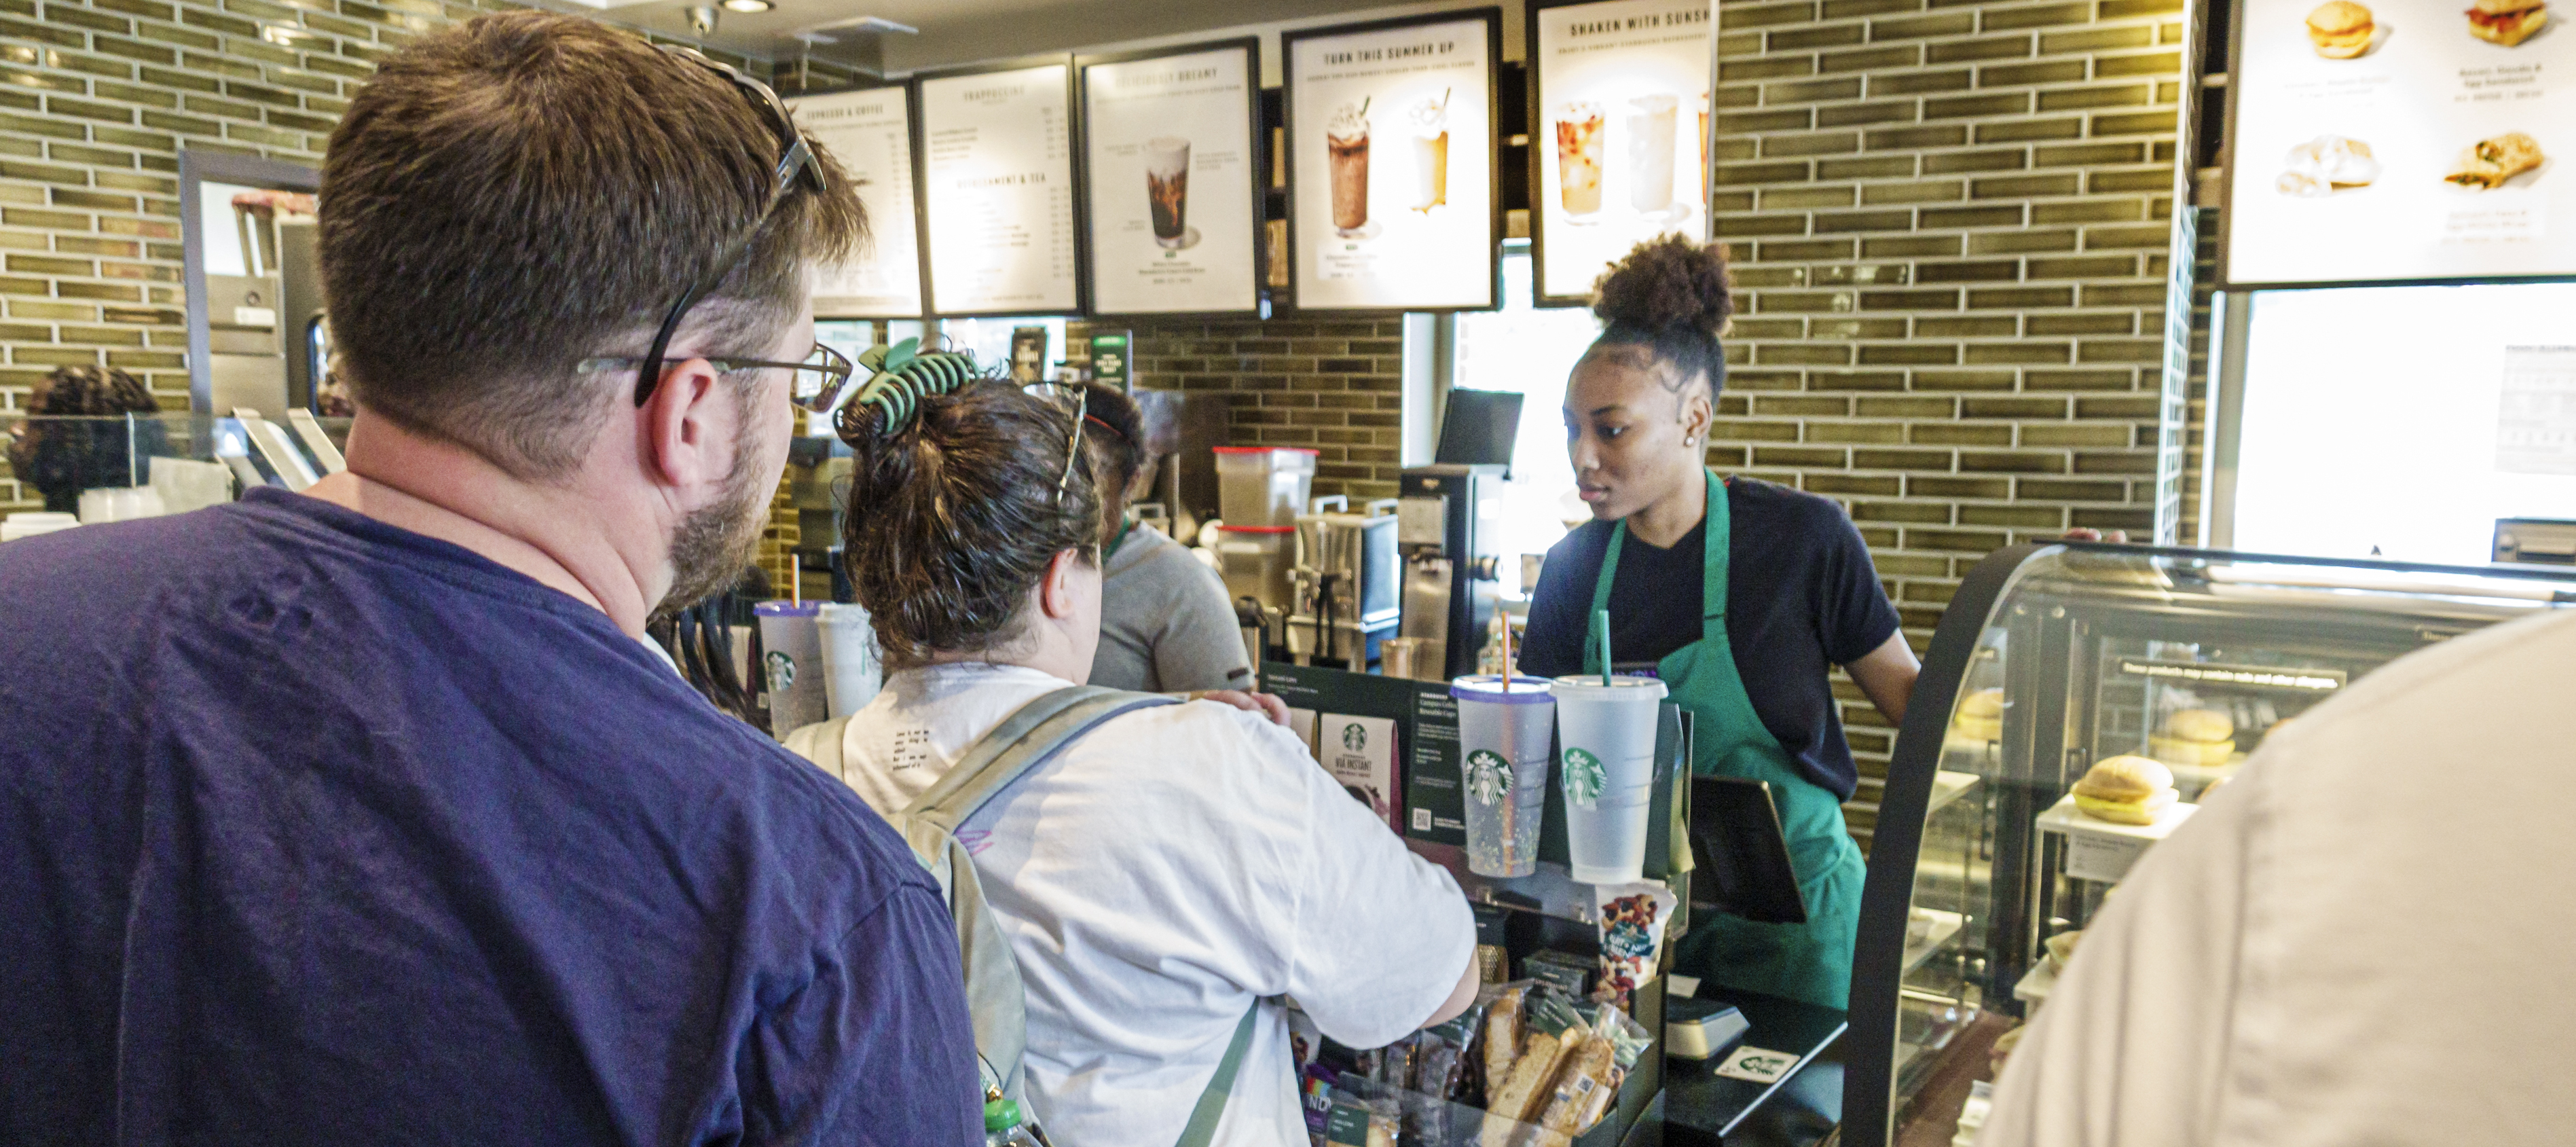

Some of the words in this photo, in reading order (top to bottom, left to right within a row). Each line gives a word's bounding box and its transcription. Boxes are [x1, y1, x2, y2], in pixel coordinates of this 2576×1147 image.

[1570, 20, 1621, 36] SHAKEN
[1628, 14, 1659, 29] WITH
[1325, 52, 1353, 65] TURN
[1359, 48, 1382, 62] THIS
[1387, 42, 1433, 60] SUMMER
[1439, 41, 1454, 54] UP
[1179, 67, 1217, 81] DREAMY
[855, 104, 883, 115] COFFEE
[1020, 173, 1026, 184] &
[1031, 172, 1046, 183] TEA
[2123, 663, 2147, 674] These
[2148, 666, 2184, 677] products
[2184, 668, 2202, 680] may
[2202, 670, 2234, 680] contain
[2253, 674, 2272, 684] and
[2272, 674, 2295, 685] other
[1336, 757, 1346, 768] VIA
[1347, 759, 1372, 771] INSTANT
